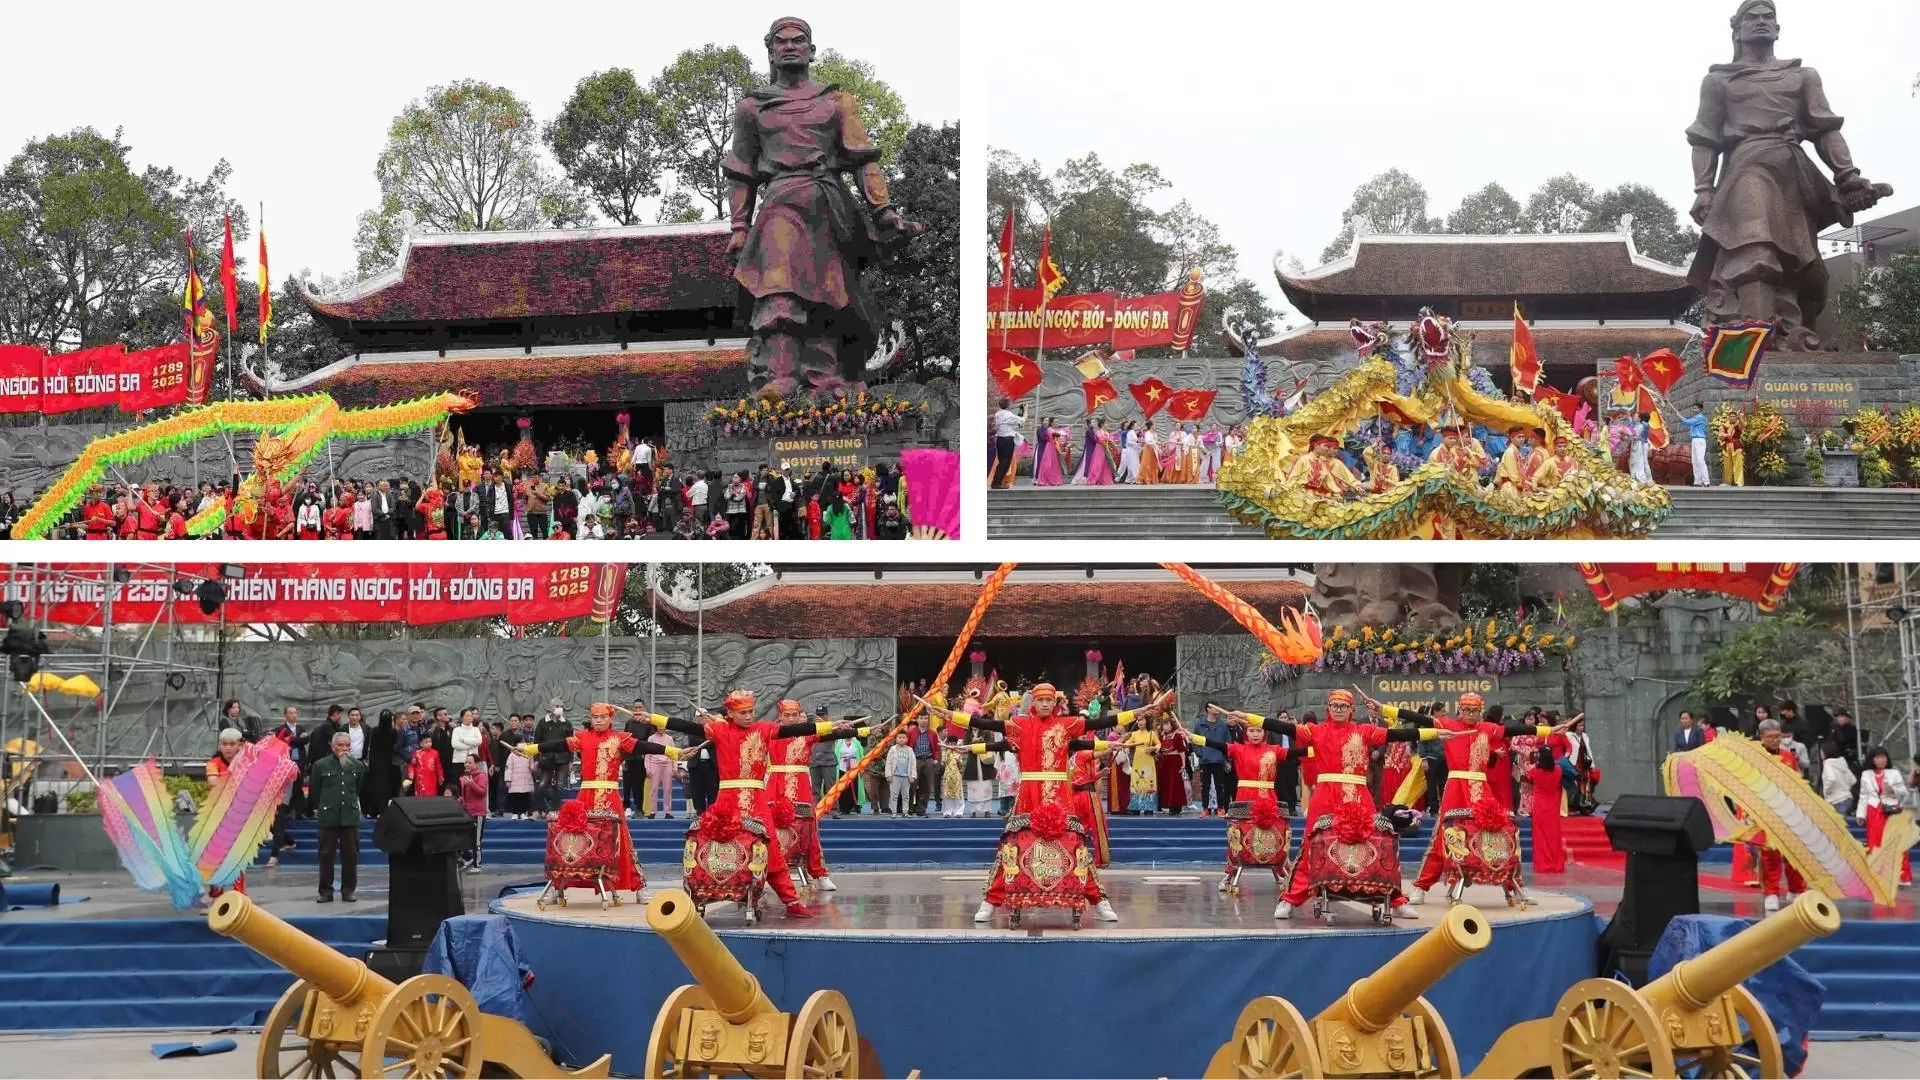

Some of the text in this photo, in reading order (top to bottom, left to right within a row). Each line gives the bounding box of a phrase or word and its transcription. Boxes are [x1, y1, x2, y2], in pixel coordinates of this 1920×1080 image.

[1045, 309, 1080, 332] NGỌC
[1114, 304, 1149, 329] ĐỐNG
[1152, 310, 1169, 329] ĐA
[152, 361, 184, 377] 1789
[0, 376, 39, 400] NGỌC
[75, 366, 116, 393] ĐỐNG
[119, 373, 140, 392] ĐA
[152, 373, 183, 389] 2025
[1764, 382, 1854, 393] QUANG TRUNG
[775, 438, 863, 451] QUANG TRUNG
[551, 565, 590, 583] 1789
[127, 579, 169, 601] 236
[281, 567, 346, 601] THẮNG
[351, 578, 402, 607] NGỌC
[409, 568, 440, 600] HỒI
[450, 568, 503, 600] ĐỐNG
[507, 578, 534, 600] ĐA
[549, 580, 589, 598] 2025
[1379, 680, 1492, 692] QUANG TRUNG
